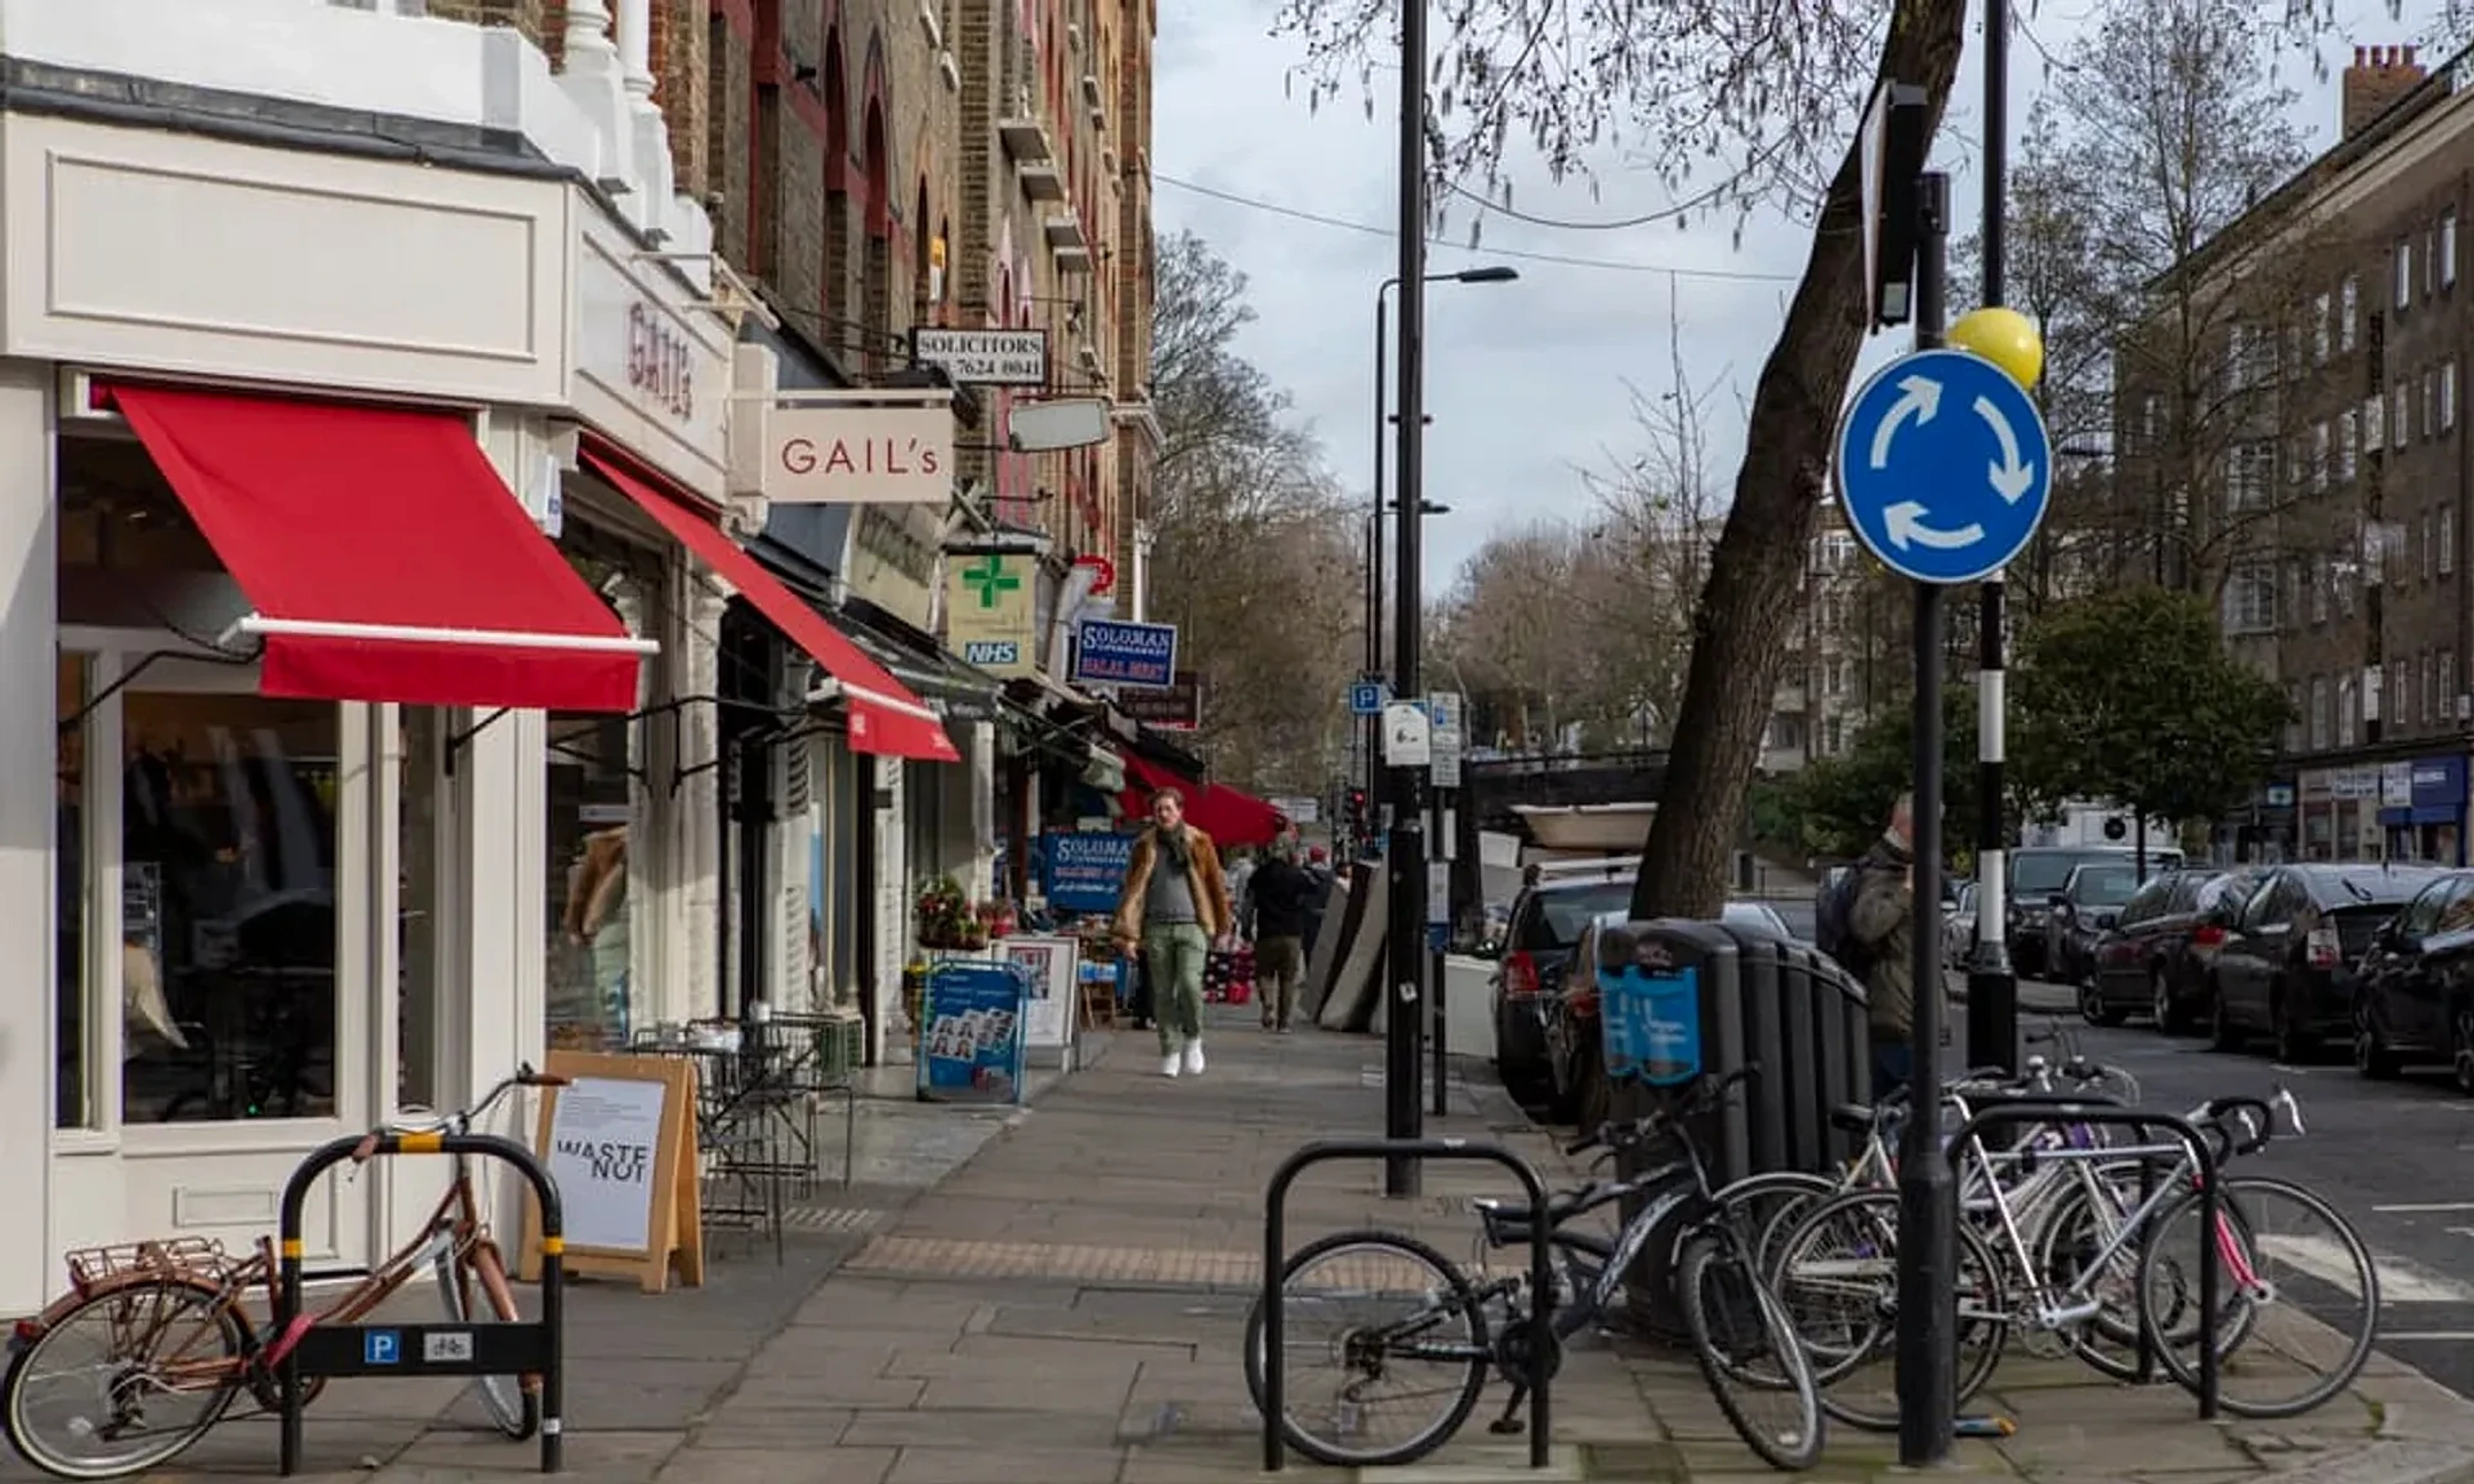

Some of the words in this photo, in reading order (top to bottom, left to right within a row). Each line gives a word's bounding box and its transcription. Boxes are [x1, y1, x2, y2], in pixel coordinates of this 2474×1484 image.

[919, 336, 1042, 353] SOLICITORS
[957, 359, 994, 375] 7624
[782, 437, 938, 475] GAIL's
[1083, 626, 1170, 649] SOLOMAN
[967, 644, 1013, 663] NHS
[1359, 689, 1374, 708] P
[557, 1139, 647, 1165] WASTE
[591, 1159, 646, 1183] NOT
[374, 1336, 392, 1360] P
